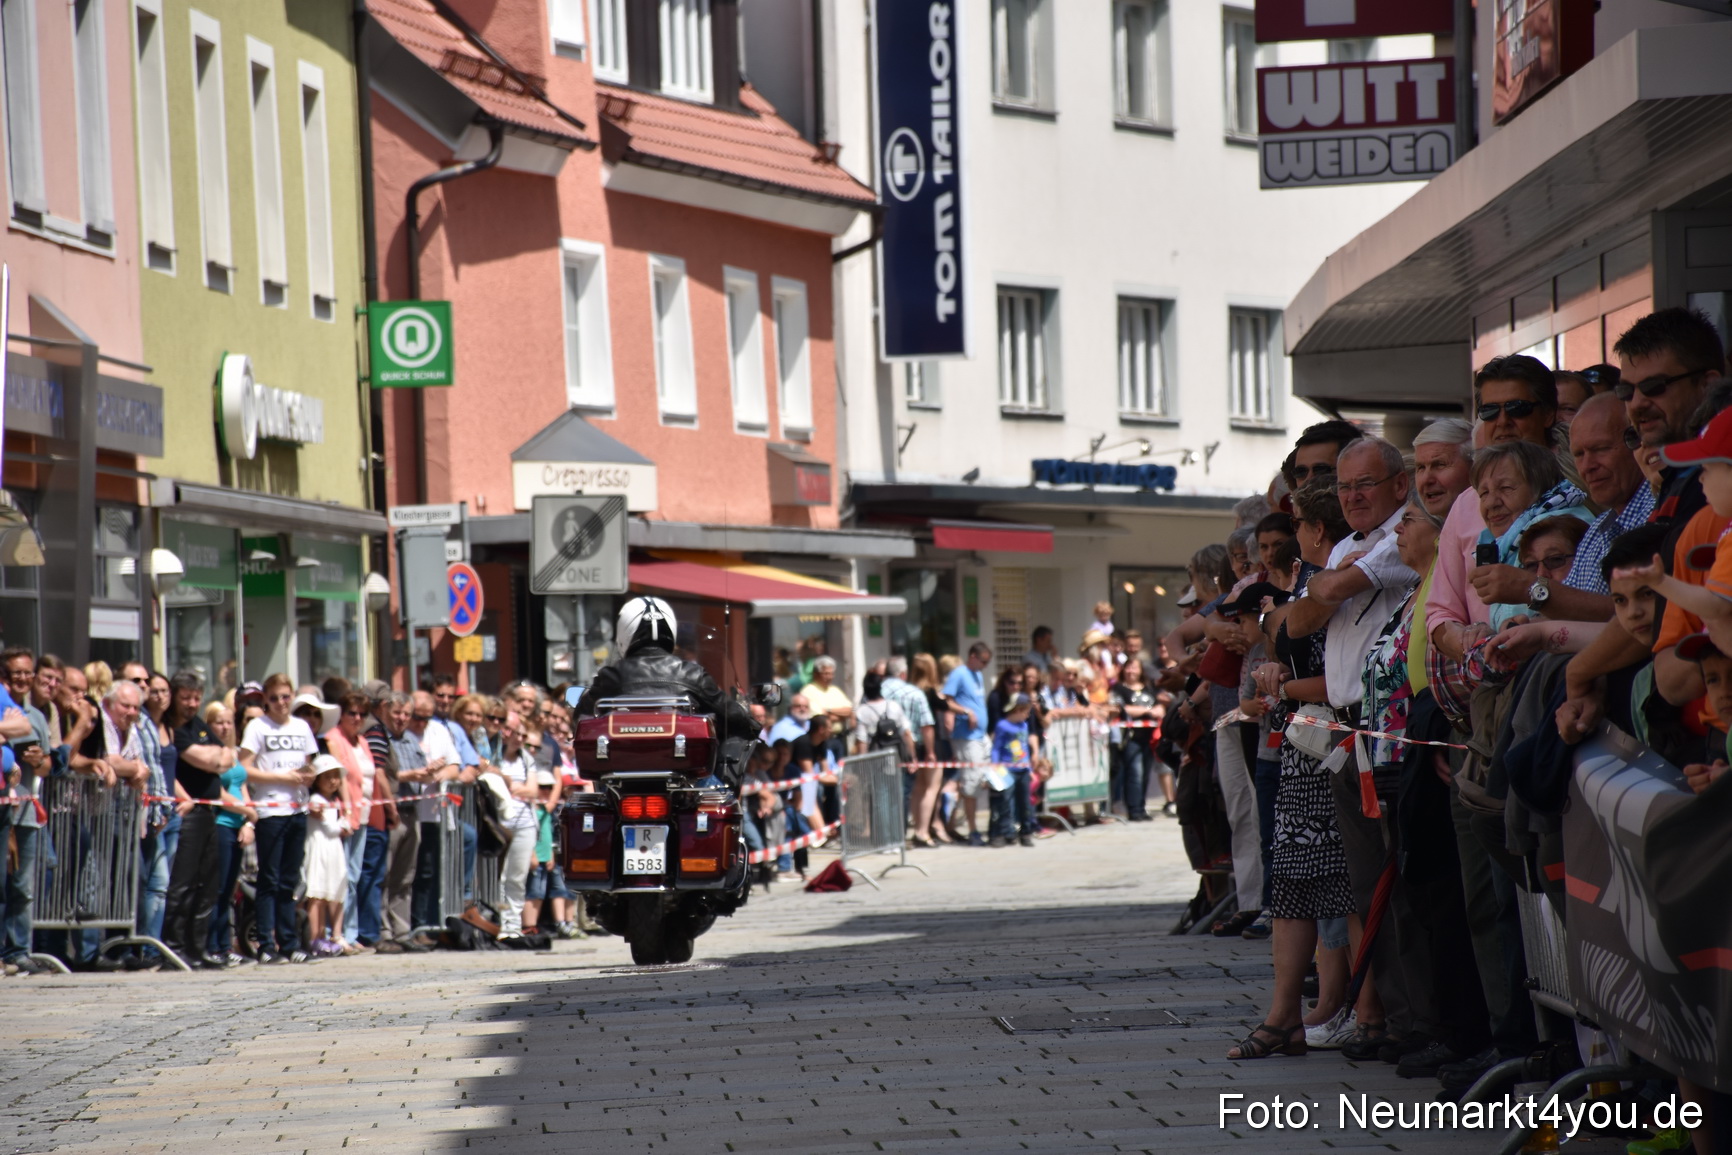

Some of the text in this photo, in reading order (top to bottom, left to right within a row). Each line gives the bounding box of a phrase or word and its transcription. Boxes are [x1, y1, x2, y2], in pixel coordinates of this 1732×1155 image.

[1264, 63, 1446, 129] WITT
[929, 2, 957, 323] TOM TAILOR
[1263, 131, 1451, 183] WEIDEN
[380, 370, 446, 381] QUICK SCHUH
[541, 464, 630, 489] Creppresso
[393, 510, 452, 523] Klostergasse
[556, 568, 601, 583] ZONE
[643, 829, 651, 841] R
[626, 859, 662, 871] G 583
